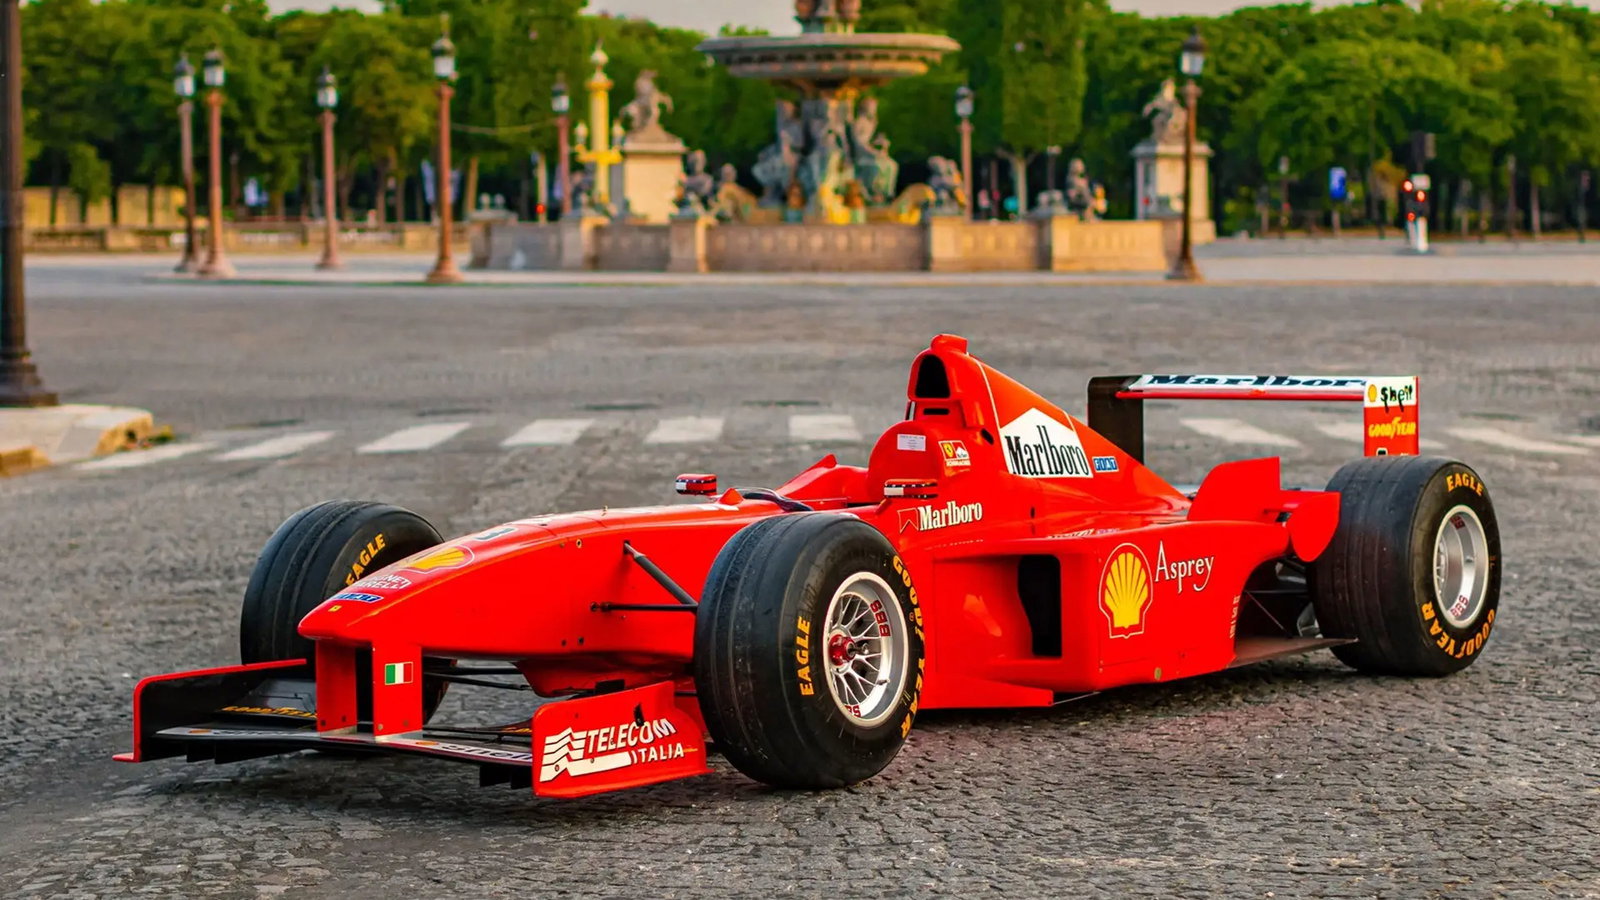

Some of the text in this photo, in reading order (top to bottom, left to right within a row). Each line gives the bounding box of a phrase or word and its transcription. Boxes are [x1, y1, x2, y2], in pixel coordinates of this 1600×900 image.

[1148, 375, 1366, 387] Marlbor
[1380, 384, 1413, 402] Shell
[1004, 425, 1089, 476] Marlboro
[1094, 458, 1117, 470] FIAT
[1446, 473, 1484, 497] EAGLE
[917, 500, 983, 531] Marlboro
[1155, 540, 1214, 594] Asprey
[869, 600, 890, 637] BBS
[1421, 601, 1495, 659] GOODYEAR
[795, 616, 815, 696] EAGLE
[588, 718, 676, 754] TELECOM
[630, 743, 684, 764] ITALIA
